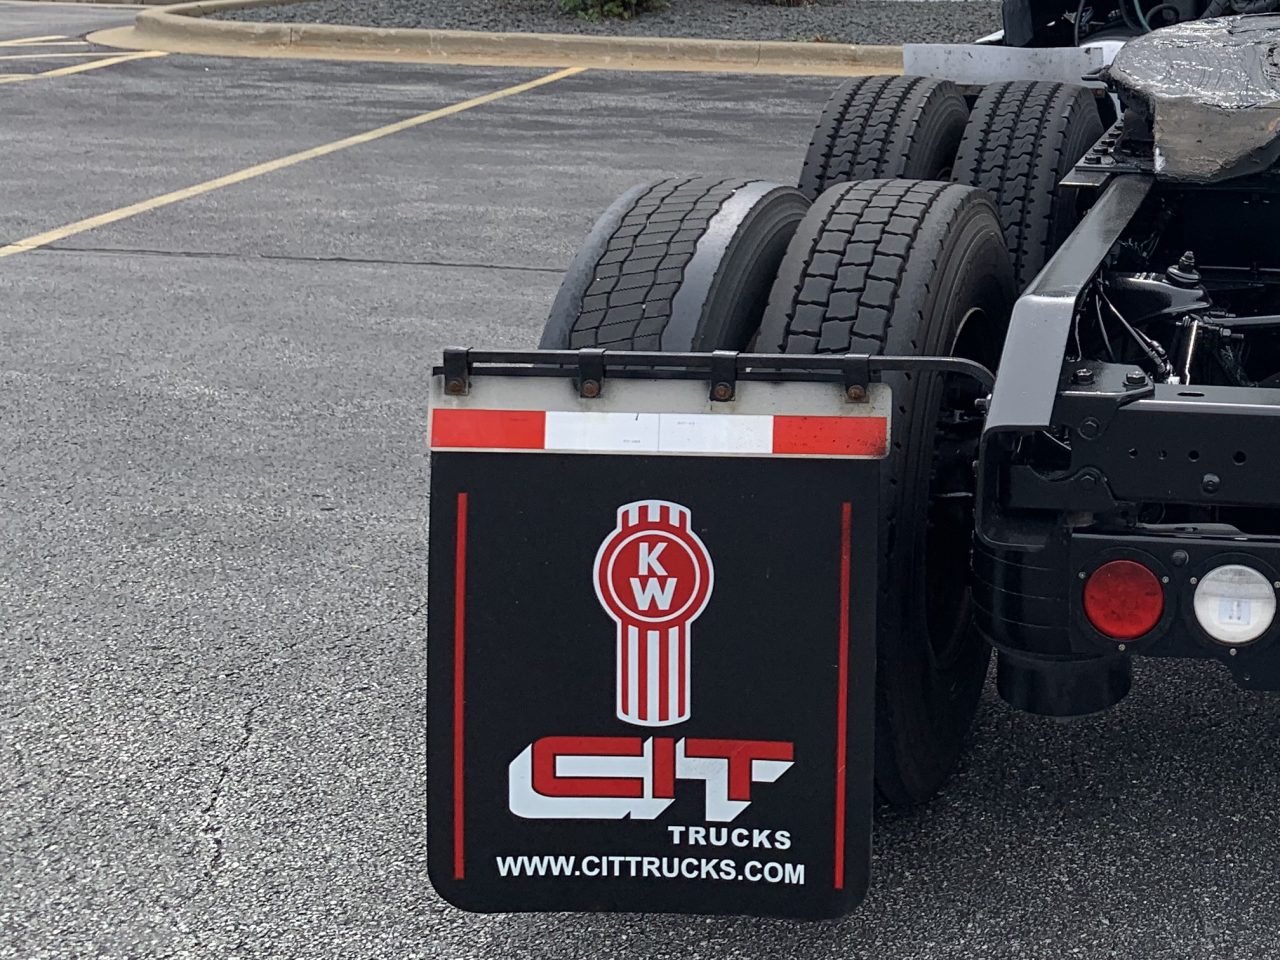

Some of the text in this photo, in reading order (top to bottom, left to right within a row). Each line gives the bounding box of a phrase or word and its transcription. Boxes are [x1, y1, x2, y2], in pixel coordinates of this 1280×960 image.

[638, 542, 668, 576] K
[630, 577, 678, 611] W
[509, 735, 795, 823] CIT
[667, 825, 792, 850] TRUCKS
[496, 855, 805, 886] WWW.CITTRUCKS.COM
